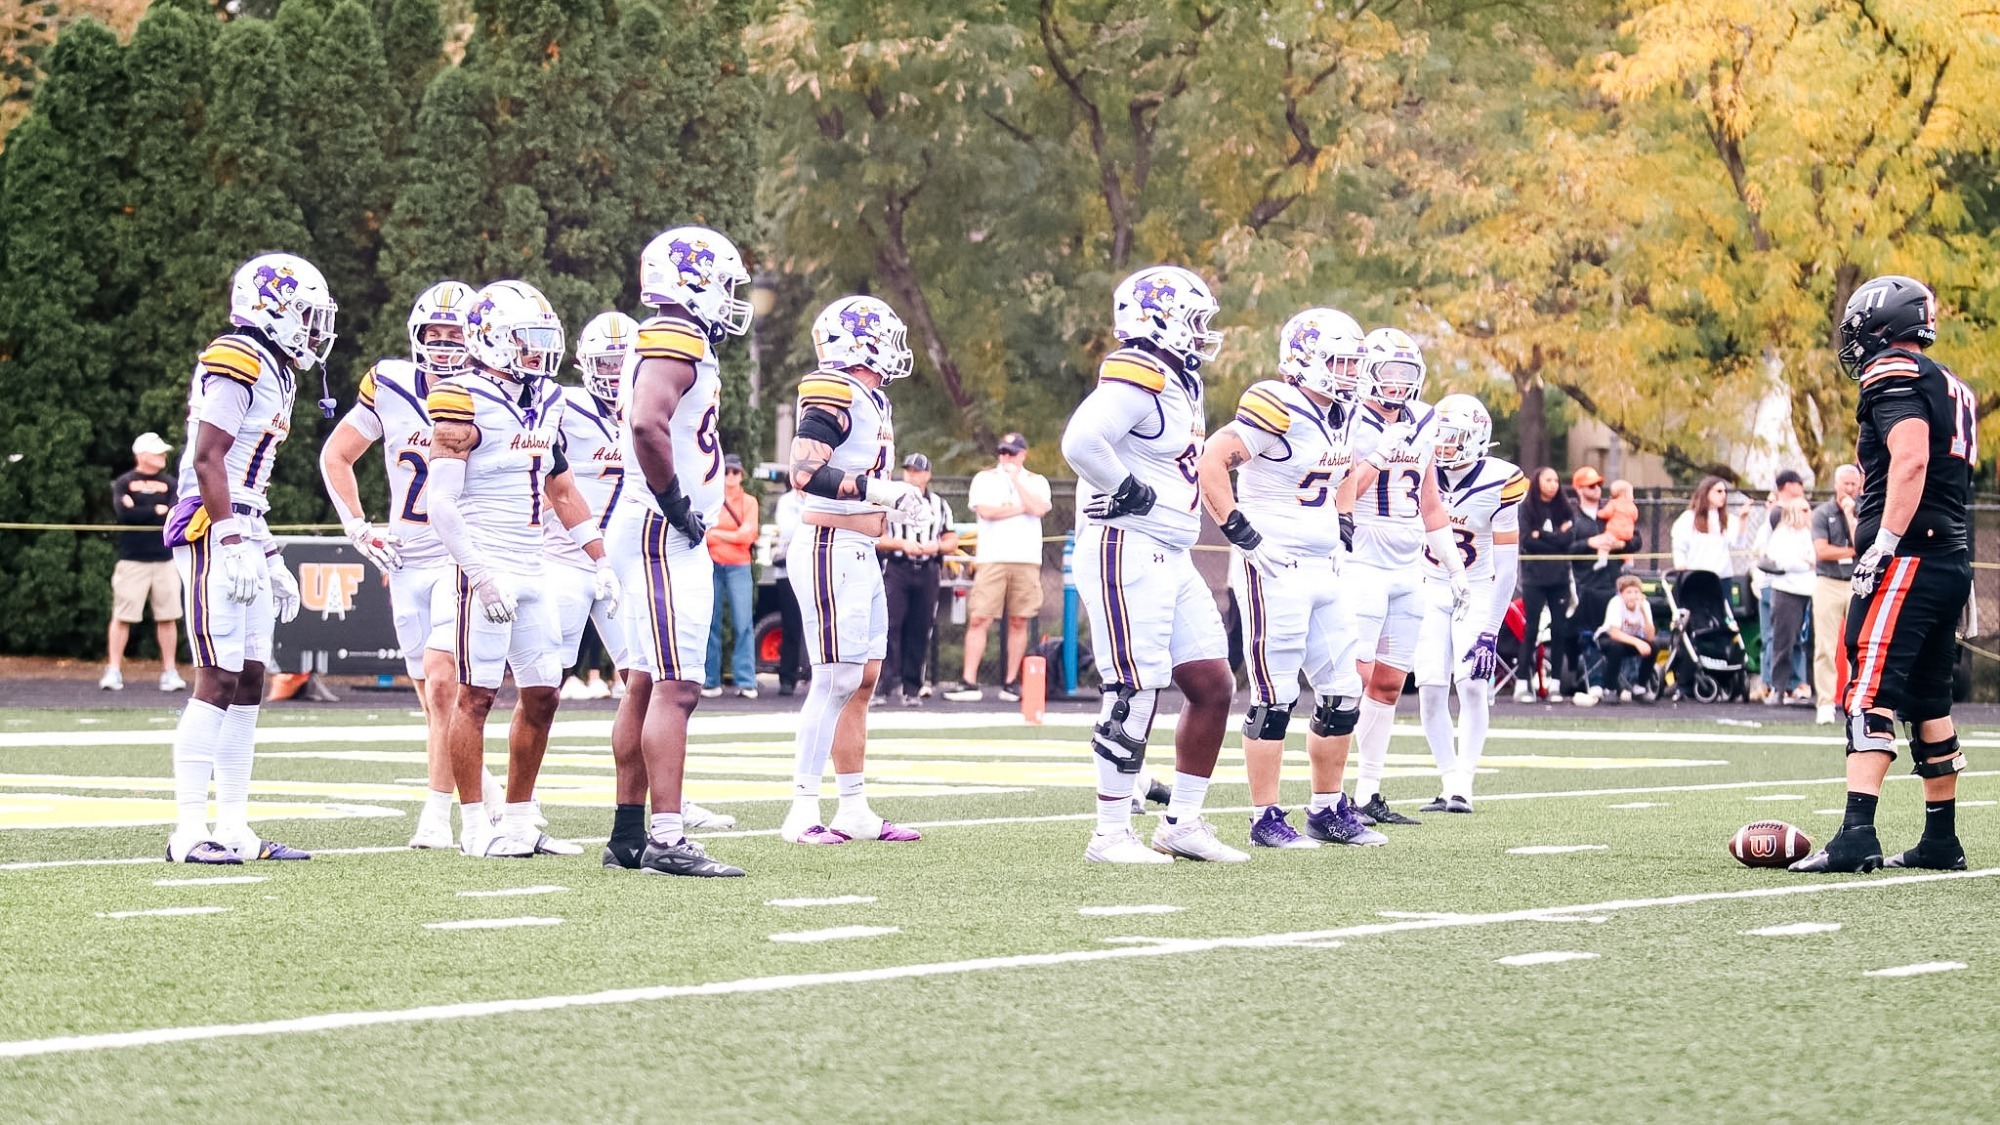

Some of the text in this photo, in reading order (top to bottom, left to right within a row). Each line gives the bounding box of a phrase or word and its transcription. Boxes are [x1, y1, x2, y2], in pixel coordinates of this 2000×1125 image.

[1861, 286, 1889, 311] 77
[510, 433, 551, 450] Ashland
[1376, 466, 1422, 519] 13
[299, 563, 365, 612] UF
